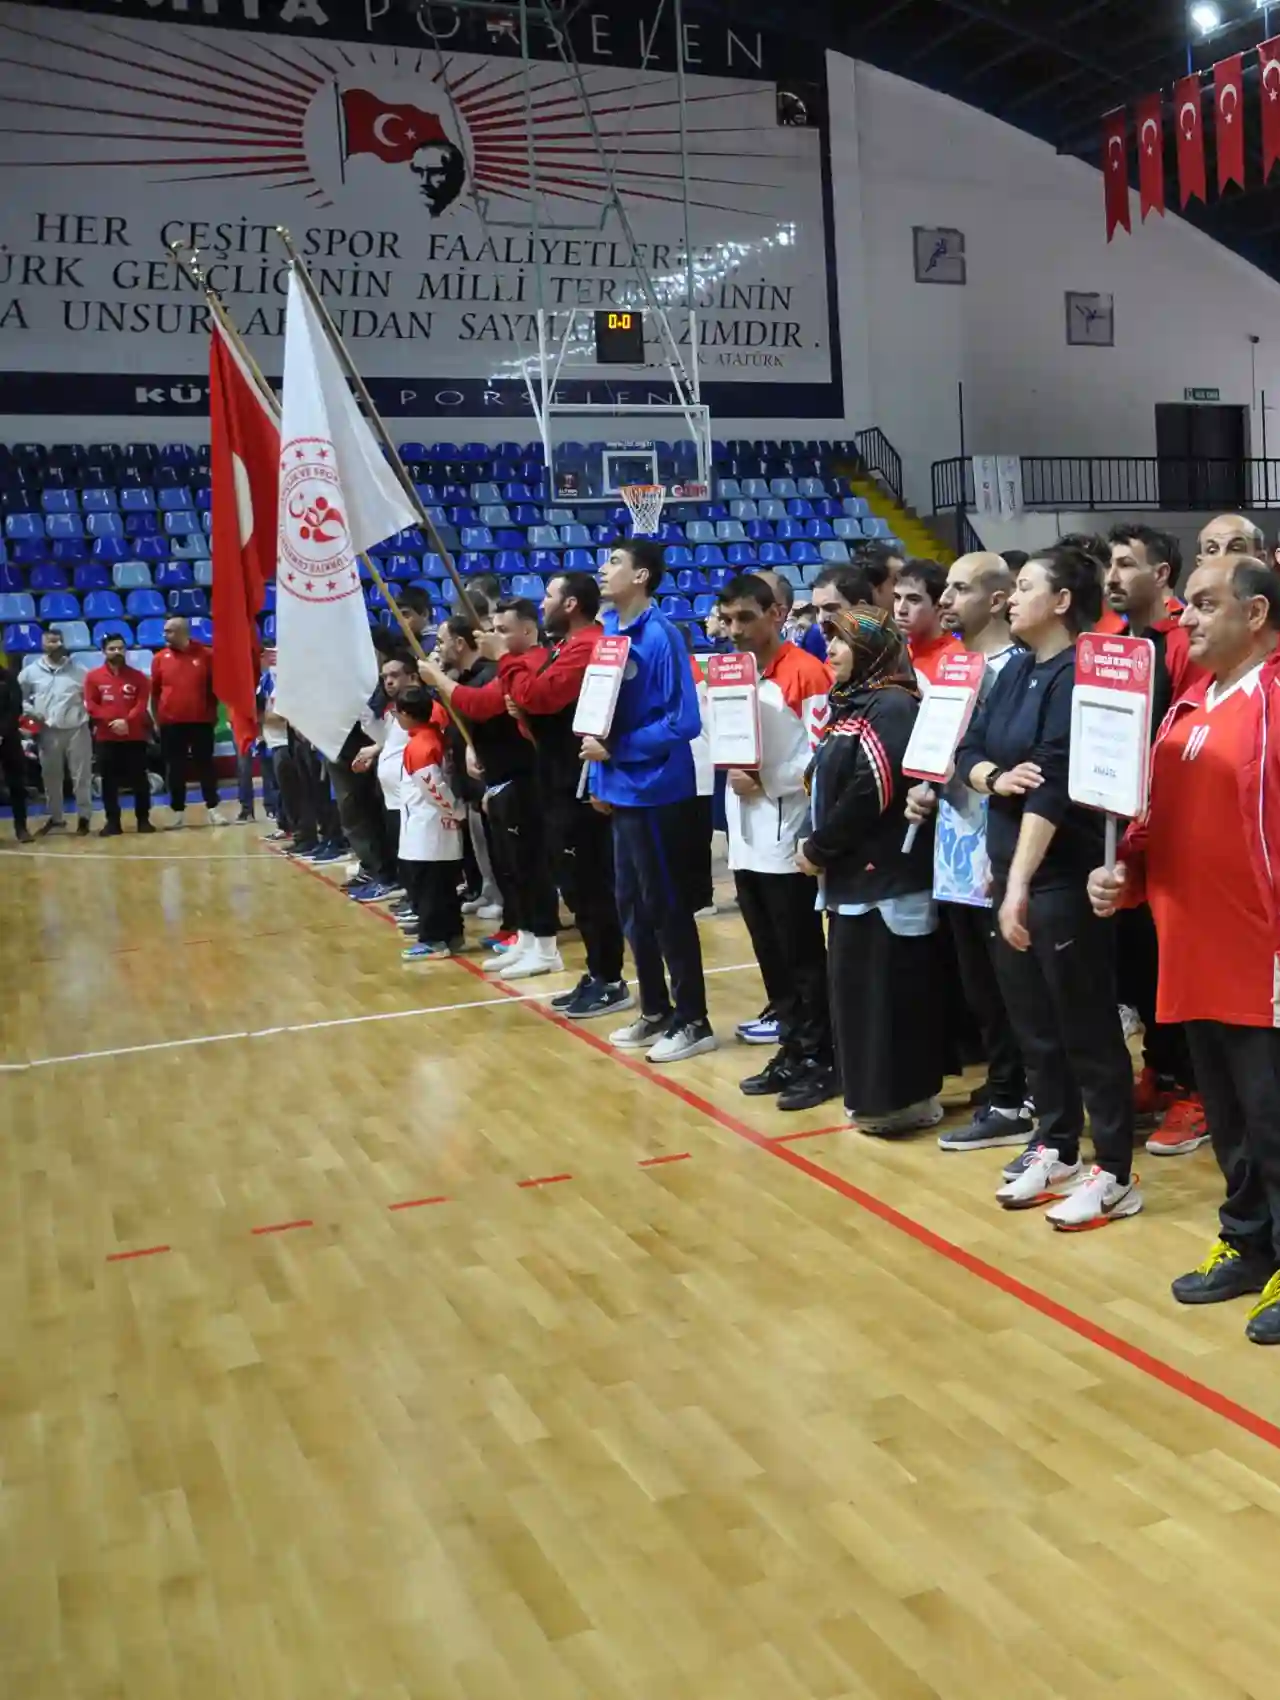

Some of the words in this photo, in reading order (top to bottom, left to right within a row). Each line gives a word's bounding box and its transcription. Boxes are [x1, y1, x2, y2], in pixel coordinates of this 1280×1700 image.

[34, 212, 132, 246] HER
[160, 214, 277, 261] ÇEŞİT
[303, 227, 403, 260] SPOR
[418, 265, 527, 304] MİLLİ
[1181, 724, 1210, 761] 10
